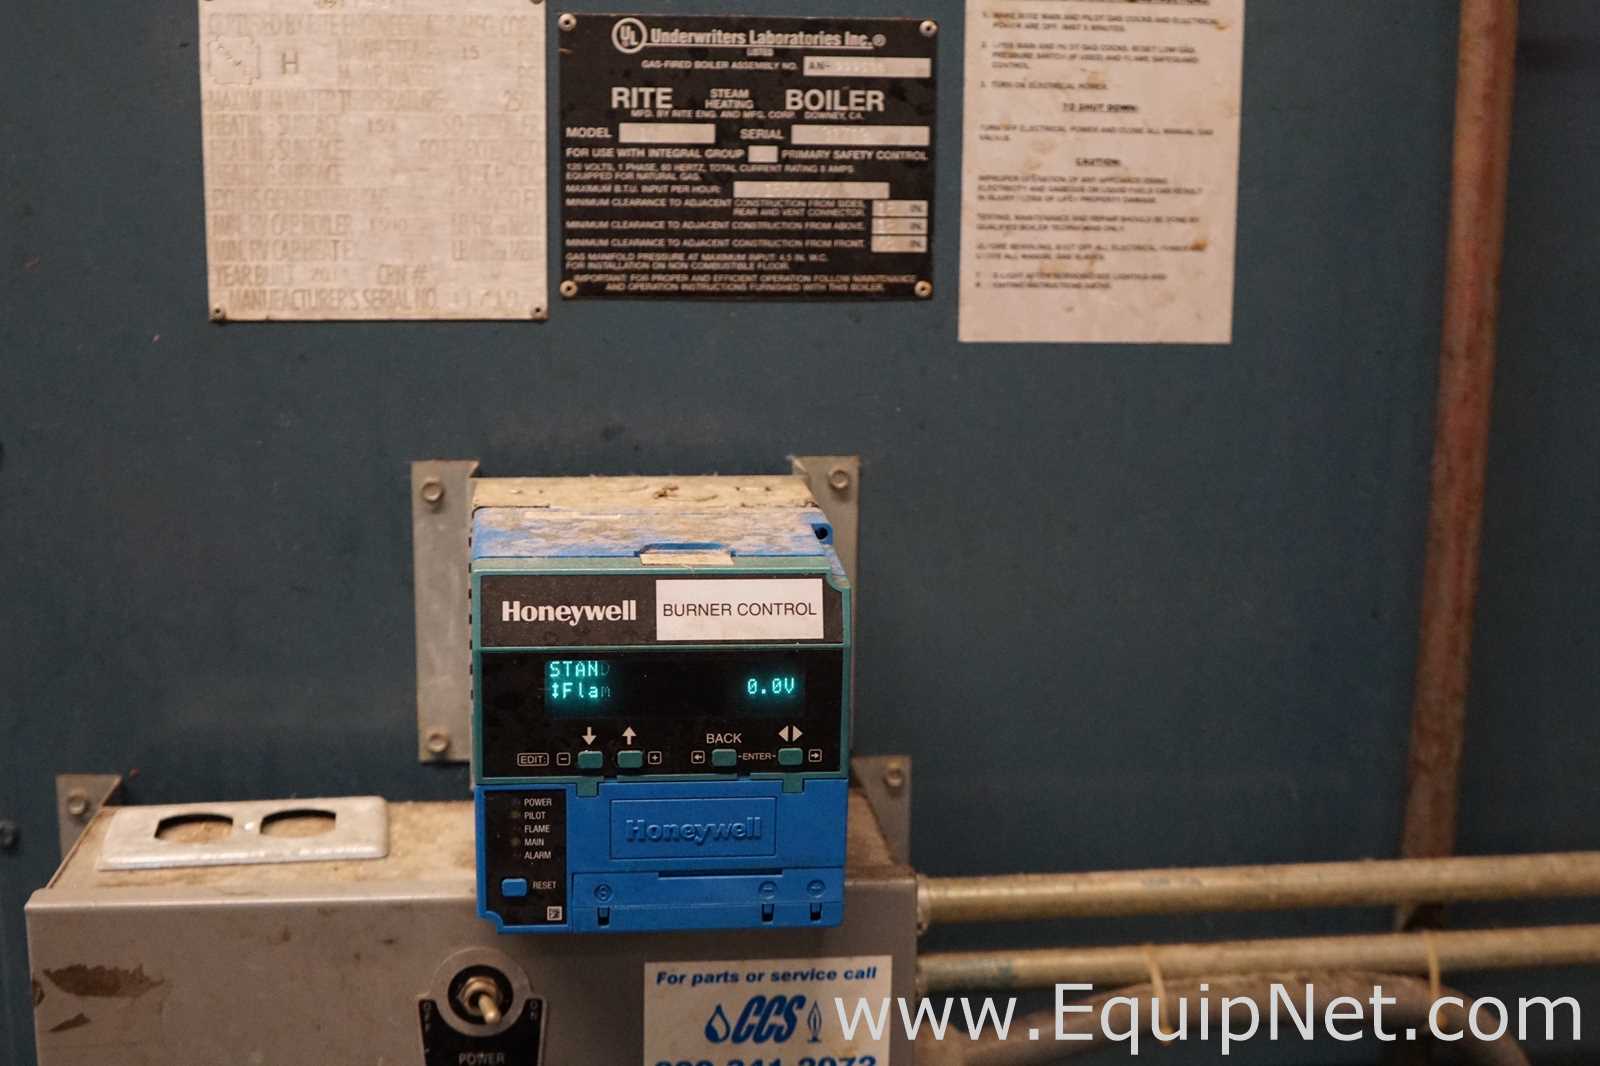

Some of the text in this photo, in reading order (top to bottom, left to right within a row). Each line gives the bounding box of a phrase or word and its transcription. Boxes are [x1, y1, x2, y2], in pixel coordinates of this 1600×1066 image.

[651, 28, 746, 44] Underwriters
[749, 29, 842, 45] Laboratories
[641, 60, 692, 69] GAS-FIRED
[694, 60, 729, 69] BOILER
[731, 61, 779, 70] ASSEMBLY
[611, 87, 673, 109] RITE
[710, 88, 749, 98] STEAM
[705, 99, 754, 109] HEATING
[785, 88, 885, 111] BOILER
[656, 110, 670, 118] BY
[672, 110, 692, 118] RITE
[720, 110, 741, 118] AND
[565, 127, 612, 138] MODEL
[741, 129, 784, 140] SERIAL
[566, 148, 745, 159] FOR USE WITH INTEGRAL GROUP
[781, 150, 831, 159] PRIMARY
[833, 151, 874, 160] SAFETY
[566, 172, 613, 180] EQUIPPED
[614, 172, 634, 180] FOR
[636, 172, 677, 181] NATURAL
[670, 185, 690, 193] PER
[611, 198, 667, 206] CLEARANCE
[669, 198, 682, 206] TO
[683, 198, 732, 206] ADJACENT
[667, 221, 681, 229] TO
[667, 239, 681, 247] TO
[502, 600, 637, 626] Honeywell
[663, 602, 817, 617] BURNER CONTROL
[747, 677, 795, 695] 0.0V
[706, 732, 742, 744] BACK
[524, 798, 552, 807] POWER
[524, 811, 547, 820] PILOT
[524, 824, 551, 833] FLAME
[626, 817, 761, 845] Honeywell
[524, 838, 544, 846] MAIN
[524, 851, 552, 860] ALARM
[532, 881, 556, 889] RESET
[656, 967, 877, 987] For parts or service call
[731, 994, 807, 1044] CCS
[458, 1052, 505, 1065] POWER
